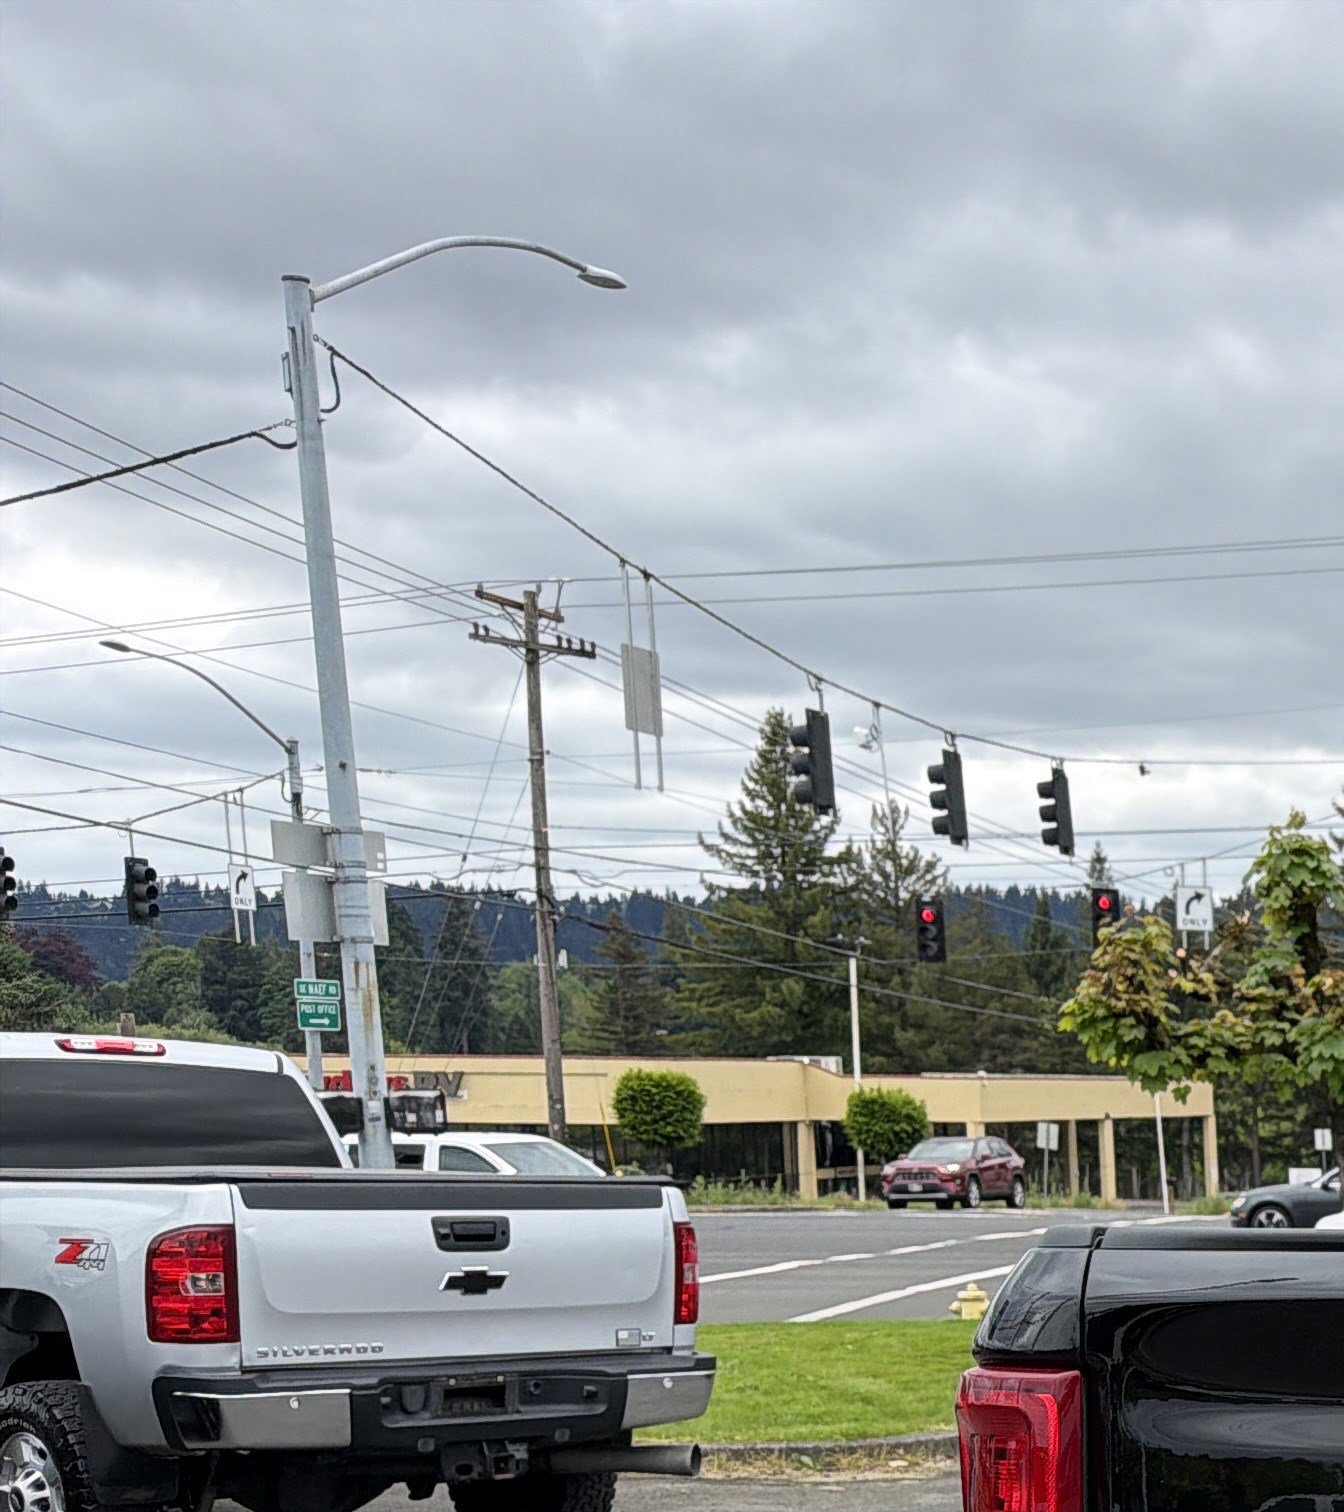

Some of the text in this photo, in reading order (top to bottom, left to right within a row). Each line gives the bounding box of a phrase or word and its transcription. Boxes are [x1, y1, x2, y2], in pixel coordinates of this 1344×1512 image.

[235, 896, 252, 906] ONLY
[1182, 918, 1208, 926] ONLY
[300, 1003, 337, 1015] POST OFFICE
[54, 1237, 110, 1265] Z71
[256, 1342, 384, 1359] SILVERADO
